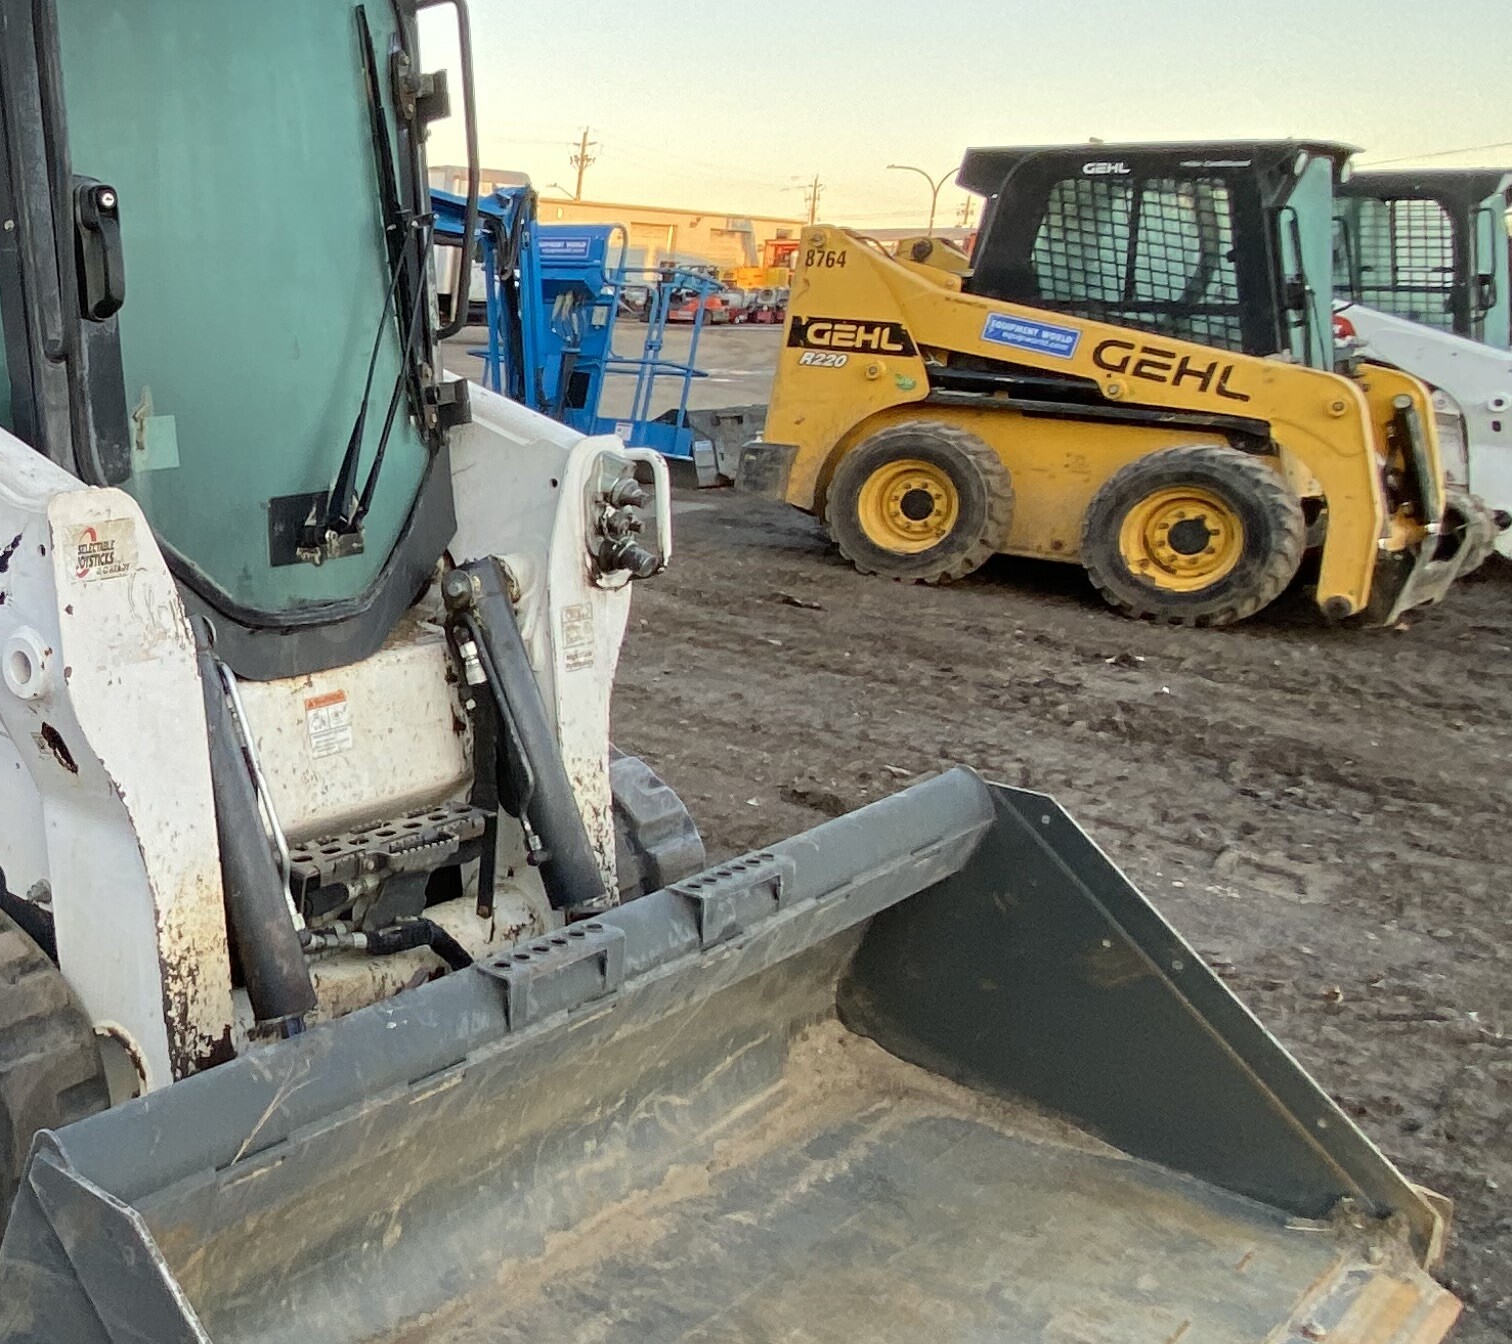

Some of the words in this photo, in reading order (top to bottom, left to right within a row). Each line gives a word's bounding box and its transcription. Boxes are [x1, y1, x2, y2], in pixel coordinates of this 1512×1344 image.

[1082, 162, 1132, 175] GEHL
[804, 248, 847, 268] 8764
[806, 322, 904, 351] GEHL
[798, 352, 848, 368] R220
[1092, 339, 1251, 403] GEHL
[76, 552, 115, 571] JOYSTICKS
